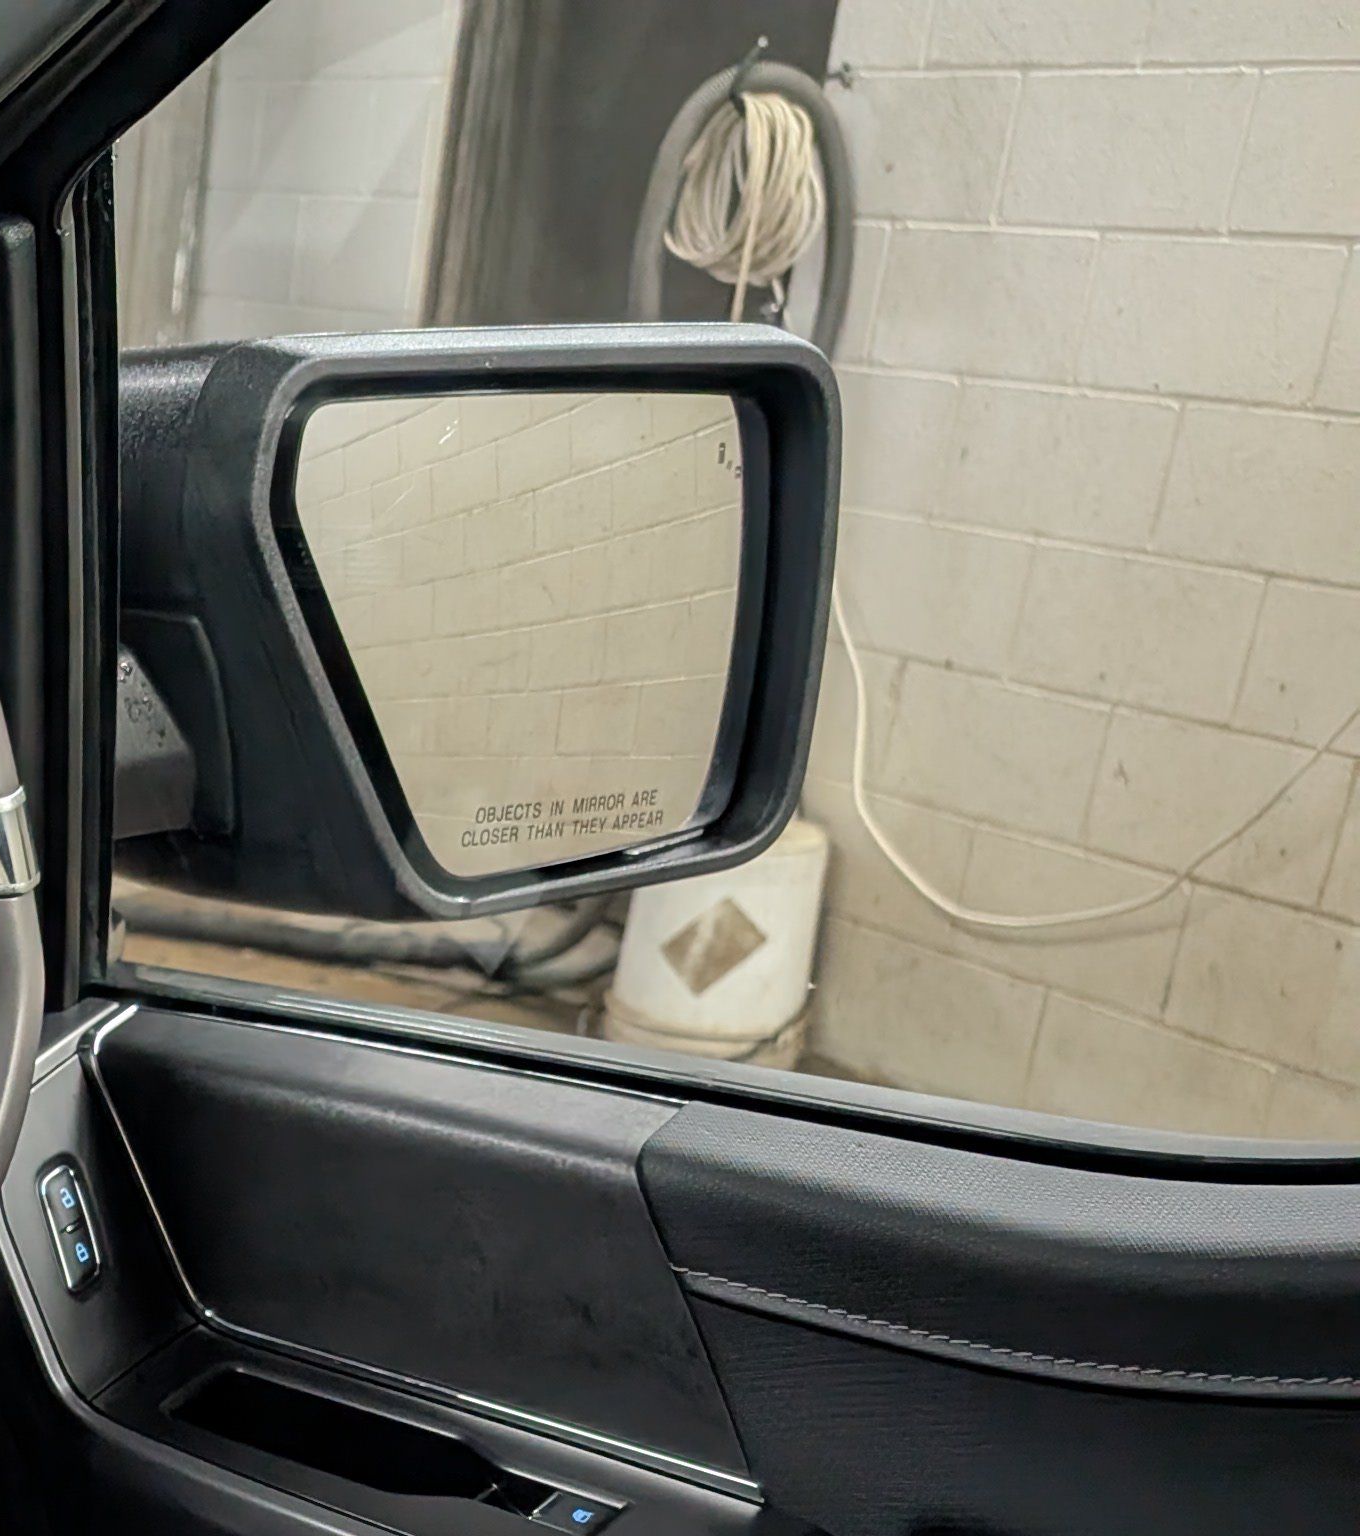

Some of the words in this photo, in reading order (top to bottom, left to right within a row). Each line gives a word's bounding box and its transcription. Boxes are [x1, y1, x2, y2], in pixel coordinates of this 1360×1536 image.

[475, 801, 543, 824] OBJECTS
[550, 800, 565, 816] IN
[572, 794, 625, 815] MIRROR
[631, 789, 659, 806] ARE
[460, 826, 520, 848] CLOSER
[527, 823, 566, 841] THAN
[572, 817, 608, 836] THEY
[612, 809, 665, 830] APPEAR
